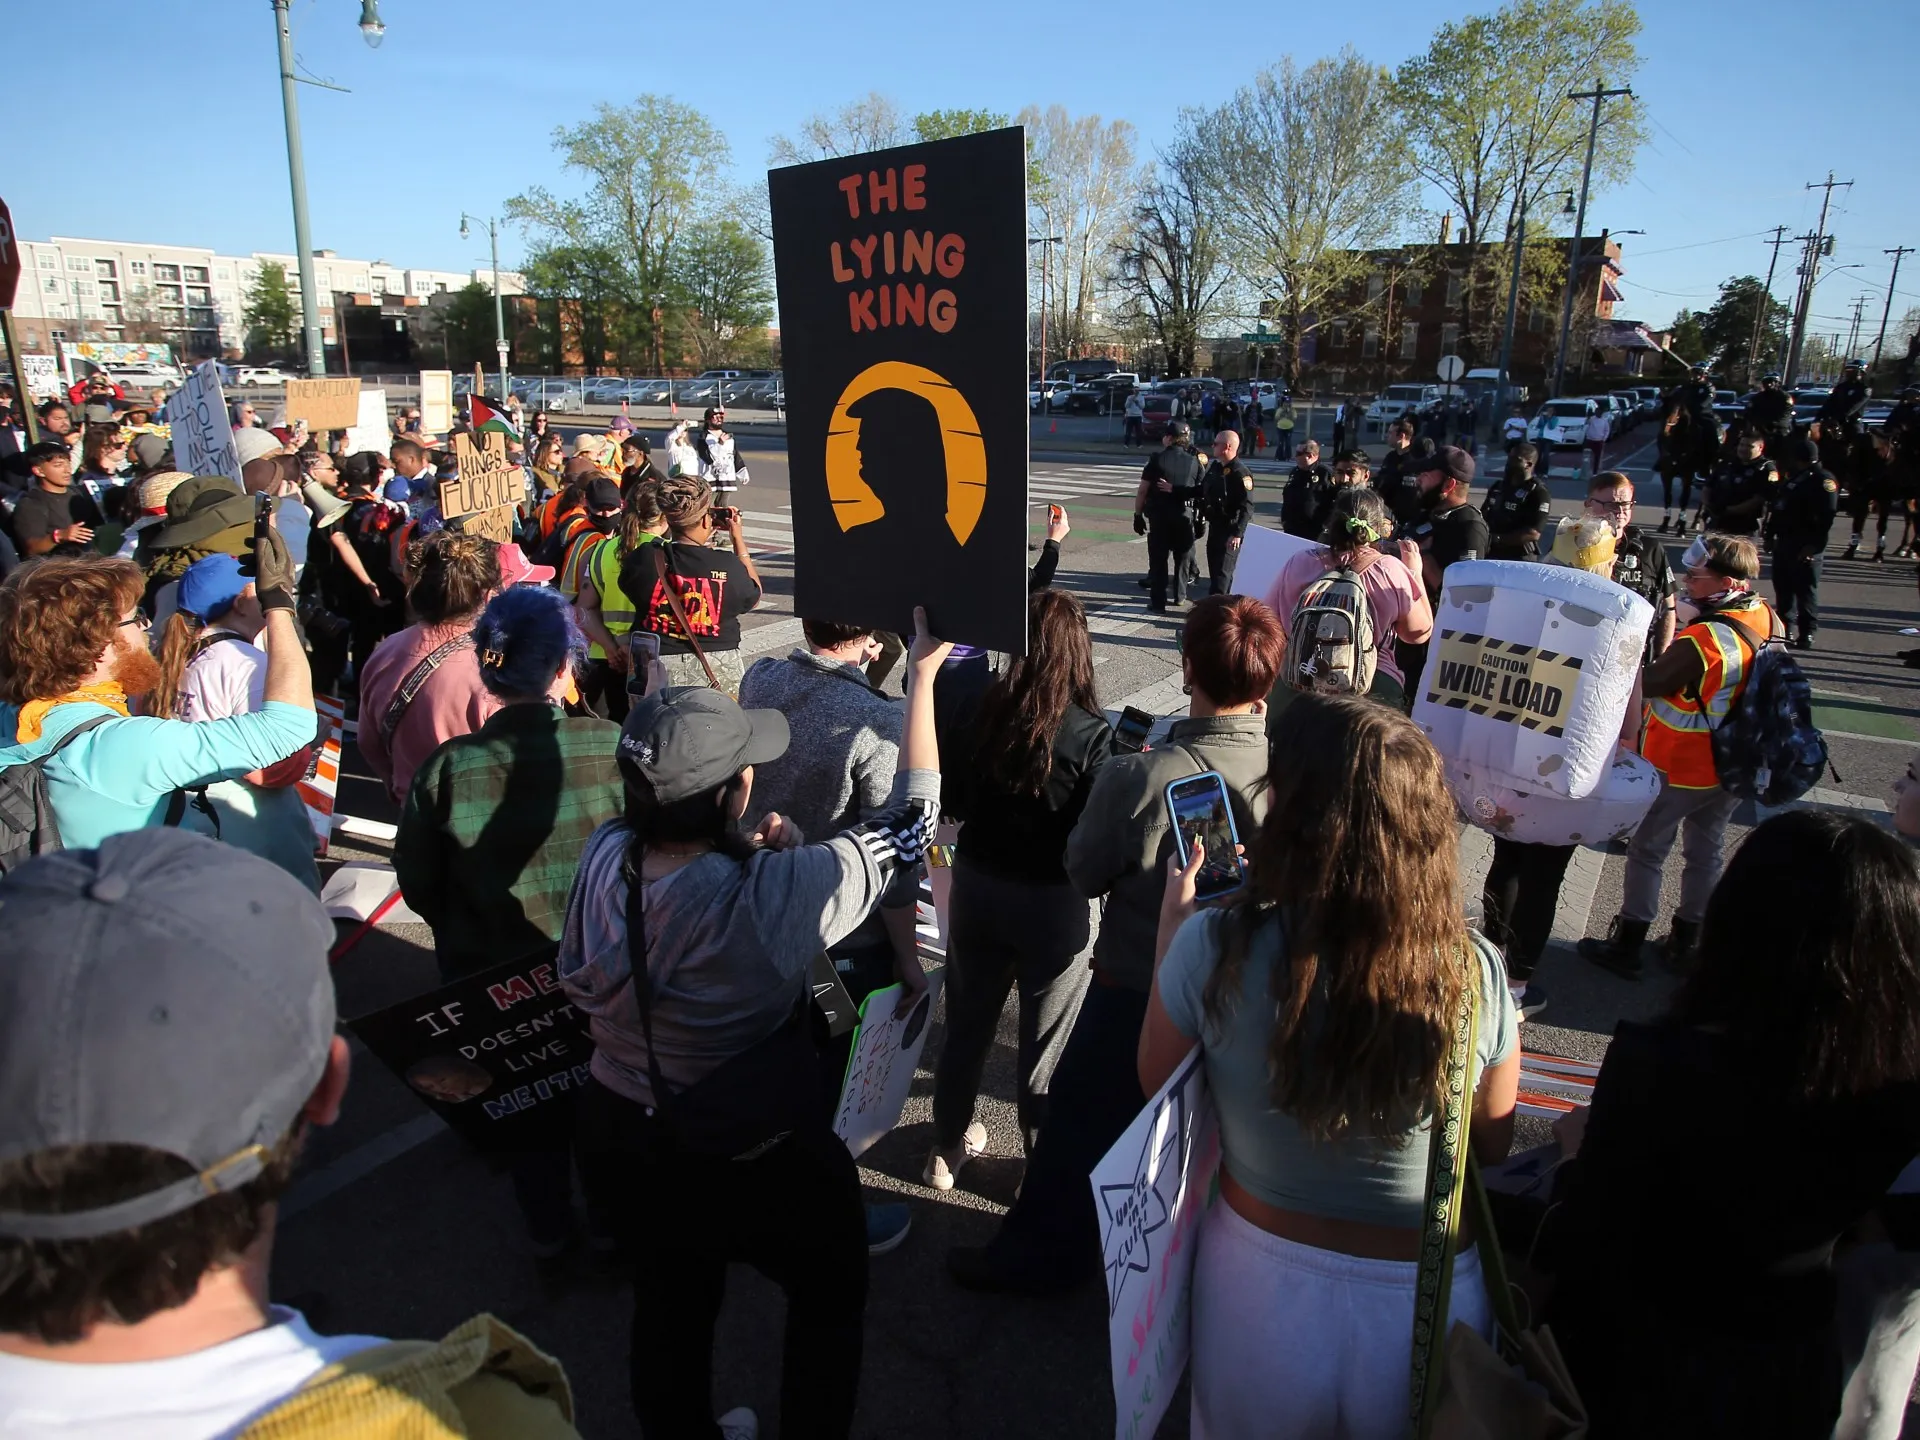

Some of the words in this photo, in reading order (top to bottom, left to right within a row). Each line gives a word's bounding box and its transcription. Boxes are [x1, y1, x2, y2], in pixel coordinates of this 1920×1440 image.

[838, 164, 927, 219] THE
[830, 229, 966, 283] LYING
[849, 282, 958, 333] KING
[291, 382, 311, 398] ONE
[313, 379, 356, 398] NATION
[460, 449, 502, 480] KINGS
[467, 431, 492, 455] NO
[444, 474, 493, 517] FUCK
[494, 468, 523, 506] ICE
[710, 570, 728, 579] THE
[1619, 570, 1642, 583] POLICE
[1481, 653, 1529, 675] CAUTION
[1438, 660, 1498, 701] WIDE
[1498, 674, 1563, 718] LOAD
[416, 1001, 464, 1036] IF
[486, 963, 562, 1011] ME
[458, 1004, 575, 1060] DOESN'T
[505, 1039, 569, 1072] LIVE
[482, 1060, 593, 1120] NEITH
